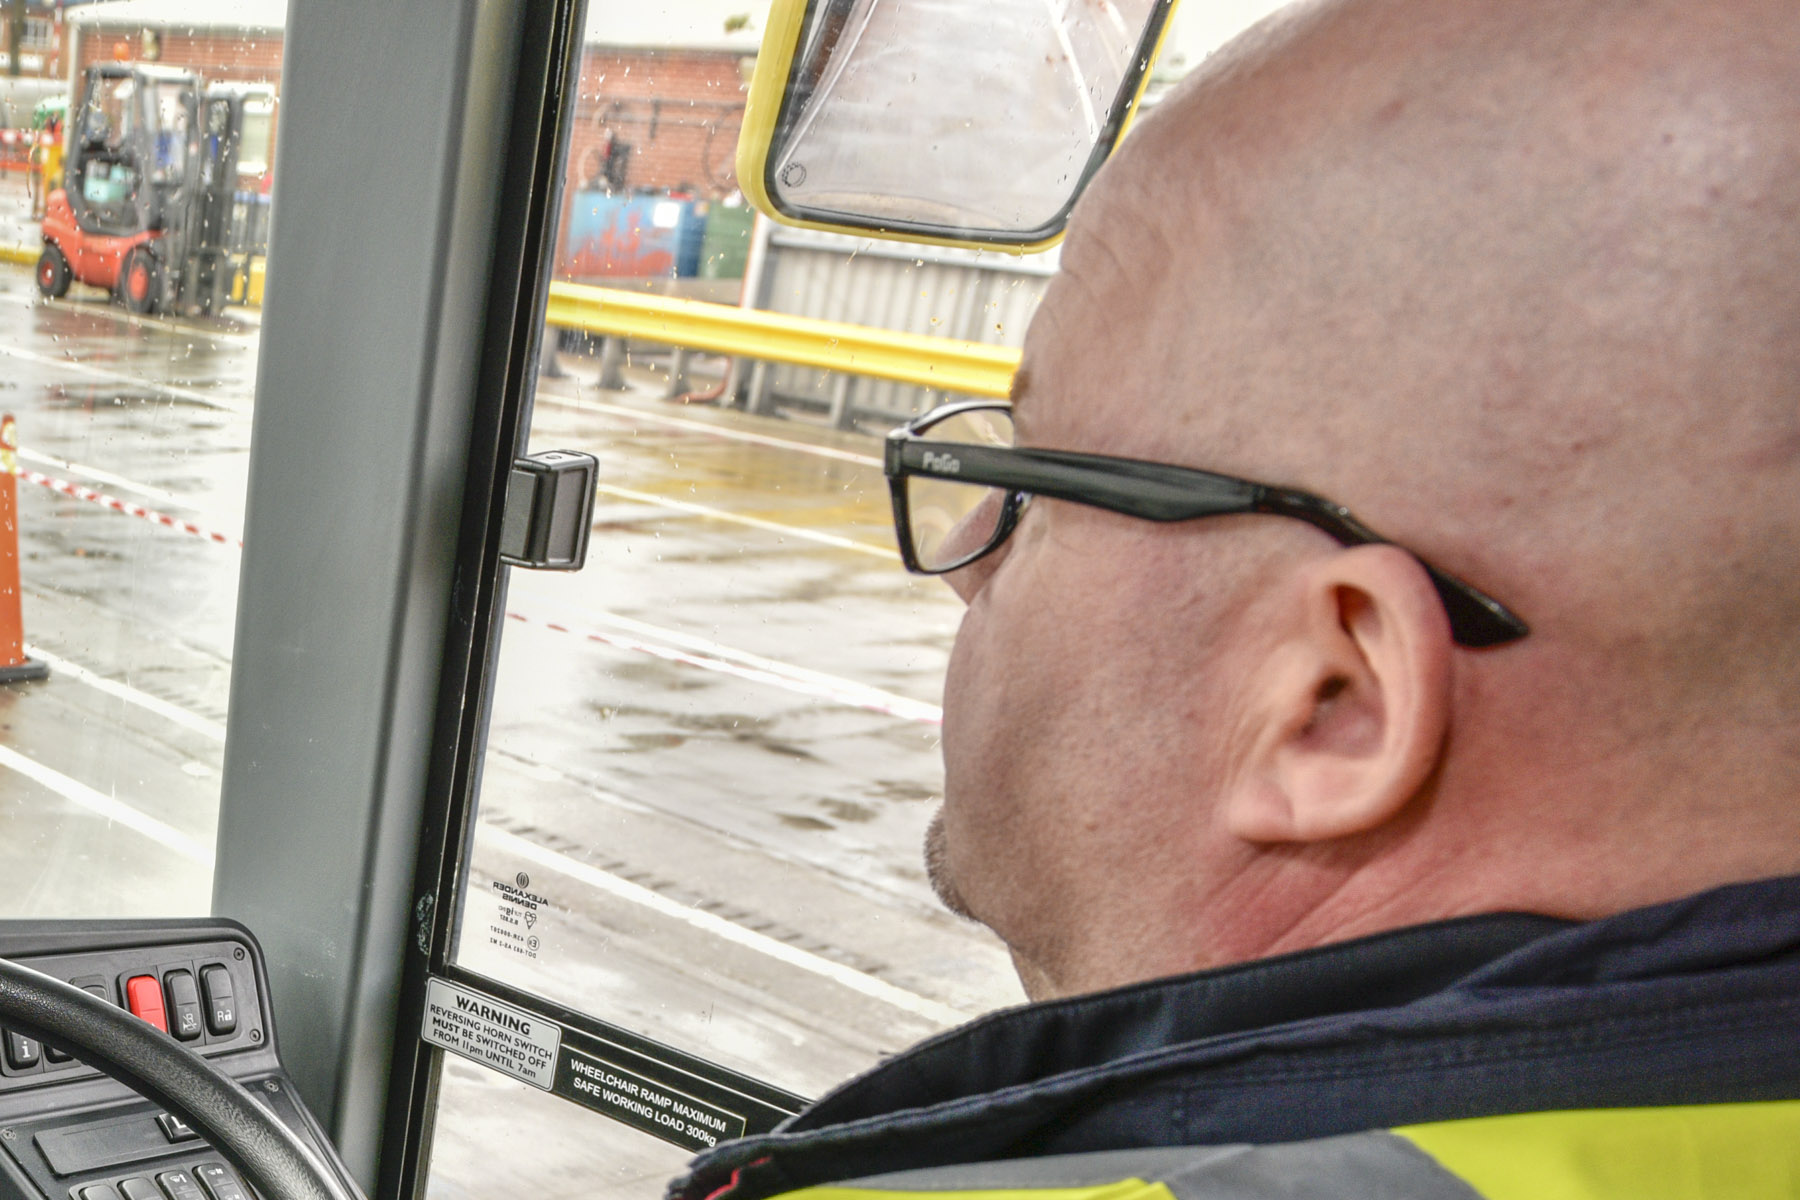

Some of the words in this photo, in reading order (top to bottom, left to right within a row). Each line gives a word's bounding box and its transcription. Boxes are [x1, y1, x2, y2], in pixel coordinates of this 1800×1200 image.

[217, 1010, 224, 1022] R
[430, 1003, 481, 1031] REVERSING
[483, 1025, 512, 1043] HORN
[514, 1038, 553, 1060] SWITCH
[456, 995, 531, 1035] WARNING
[432, 1017, 460, 1034] MUST
[462, 1028, 474, 1040] BE
[476, 1034, 526, 1061] SWITCHED
[528, 1056, 547, 1069] OFF
[433, 1028, 459, 1046] FROM
[462, 1039, 483, 1055] 11pm
[486, 1049, 514, 1069] UNTIL
[517, 1063, 536, 1078] 7am
[571, 1058, 639, 1097] WHEELCHAIR
[640, 1088, 672, 1108] RAMP
[673, 1101, 727, 1132] MAXIMUM
[574, 1077, 601, 1097] SAFE
[602, 1089, 653, 1118] WORKING
[654, 1110, 685, 1131] LOAD
[686, 1124, 717, 1147] 300kg
